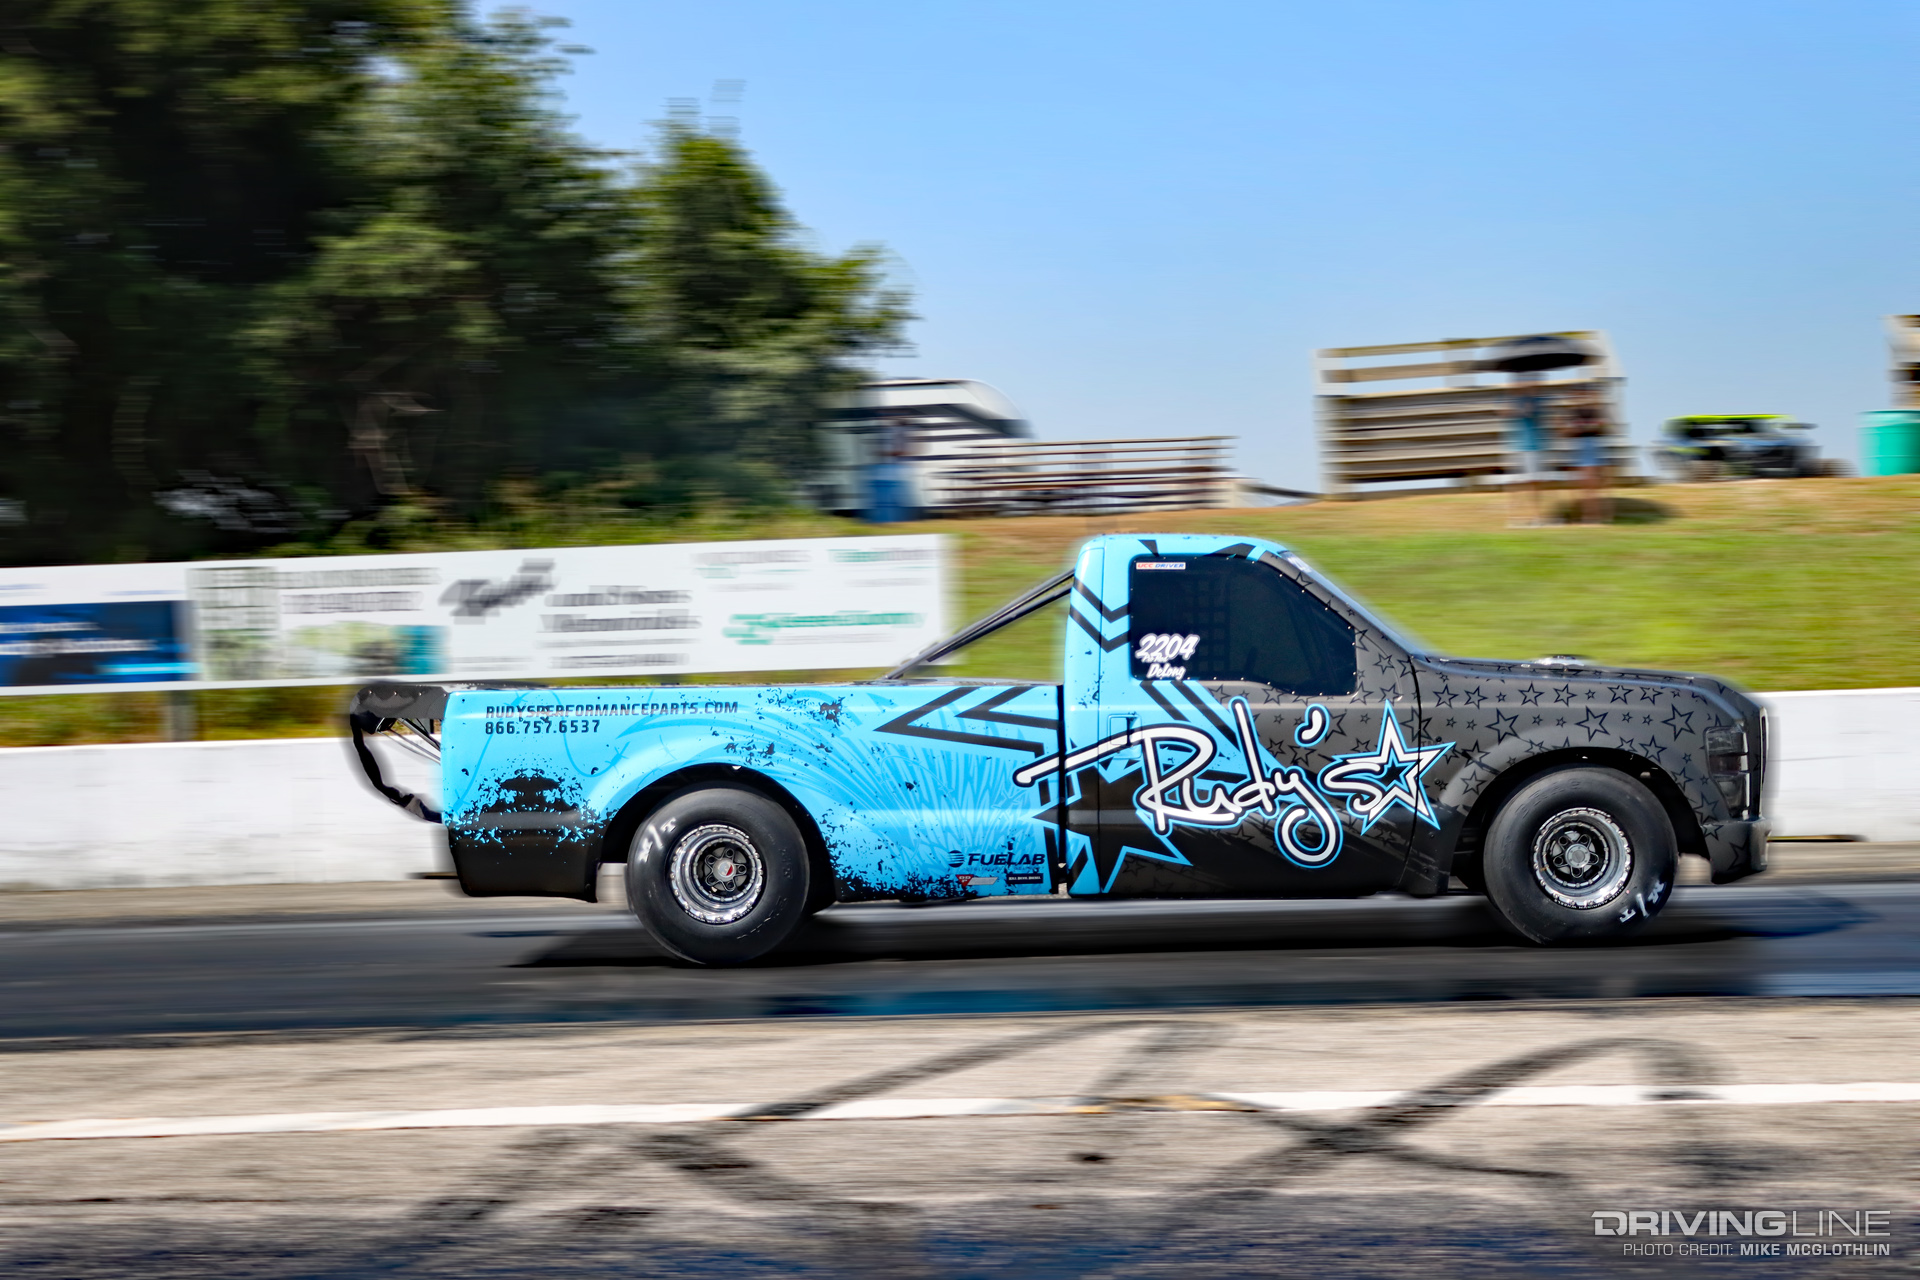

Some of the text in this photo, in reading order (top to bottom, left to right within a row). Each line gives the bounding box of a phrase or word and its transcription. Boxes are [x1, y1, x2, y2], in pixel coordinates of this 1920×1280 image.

[1135, 633, 1200, 660] 2204
[1146, 662, 1186, 680] DeLong
[486, 701, 738, 719] RUDYSPERFORMANCEPARTS.COM
[485, 719, 600, 734] 866.757.6537
[1014, 697, 1400, 867] Rudy's
[968, 853, 1046, 866] FUELAB
